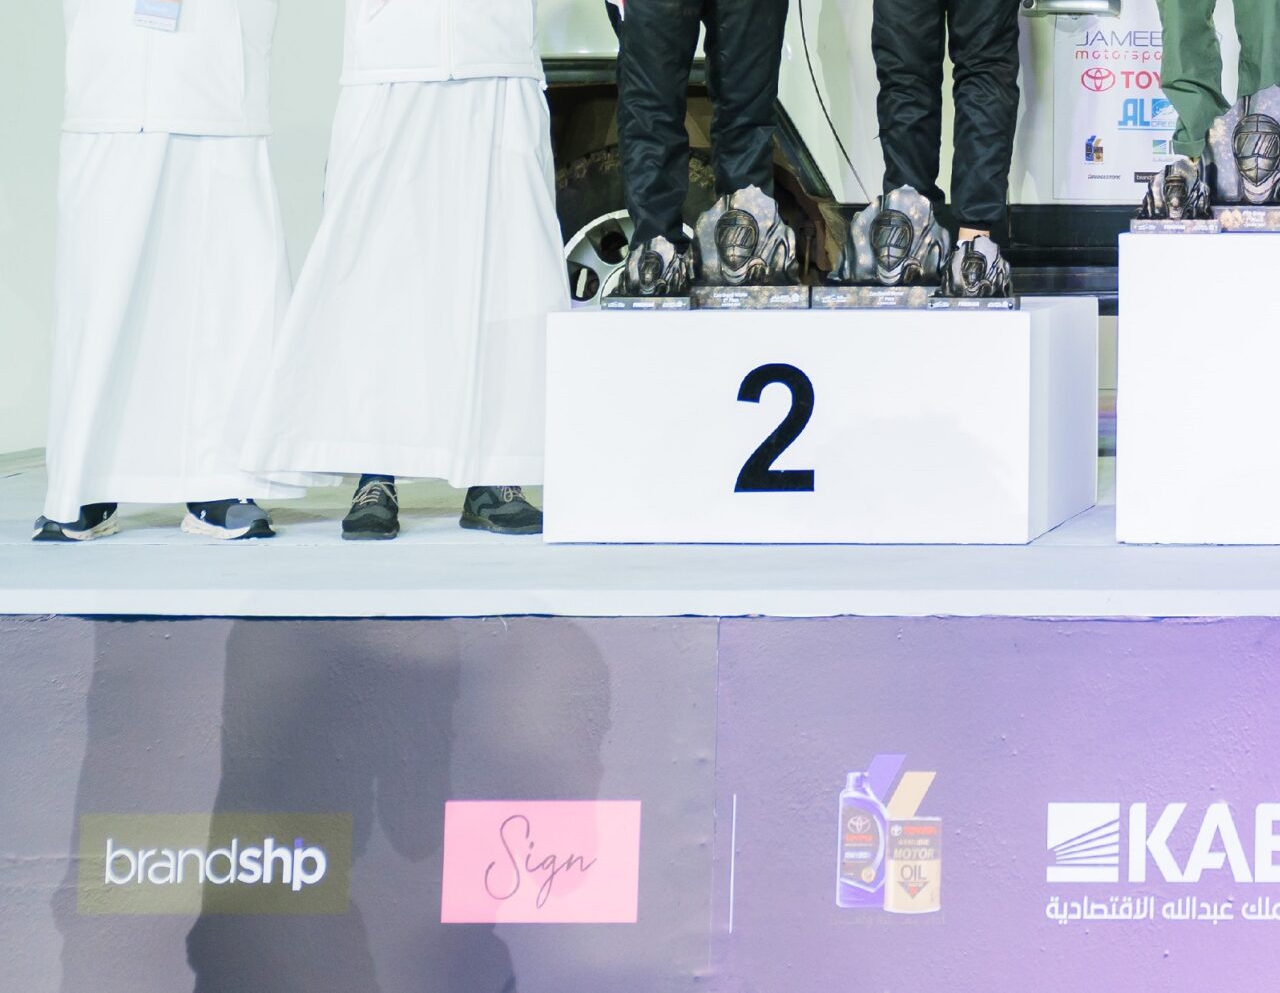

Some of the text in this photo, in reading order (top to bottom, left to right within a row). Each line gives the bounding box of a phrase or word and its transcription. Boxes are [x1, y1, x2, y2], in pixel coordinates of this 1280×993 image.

[1075, 30, 1164, 47] JAMEE
[1075, 49, 1163, 64] motorspo
[1120, 70, 1163, 89] TOY
[1117, 98, 1150, 128] AL
[733, 362, 816, 493] 2
[104, 837, 328, 892] brandshp
[484, 814, 598, 909] Sign
[893, 847, 934, 860] MOTOR
[900, 864, 928, 881] OIL
[1045, 895, 1156, 923] الاقتصادية
